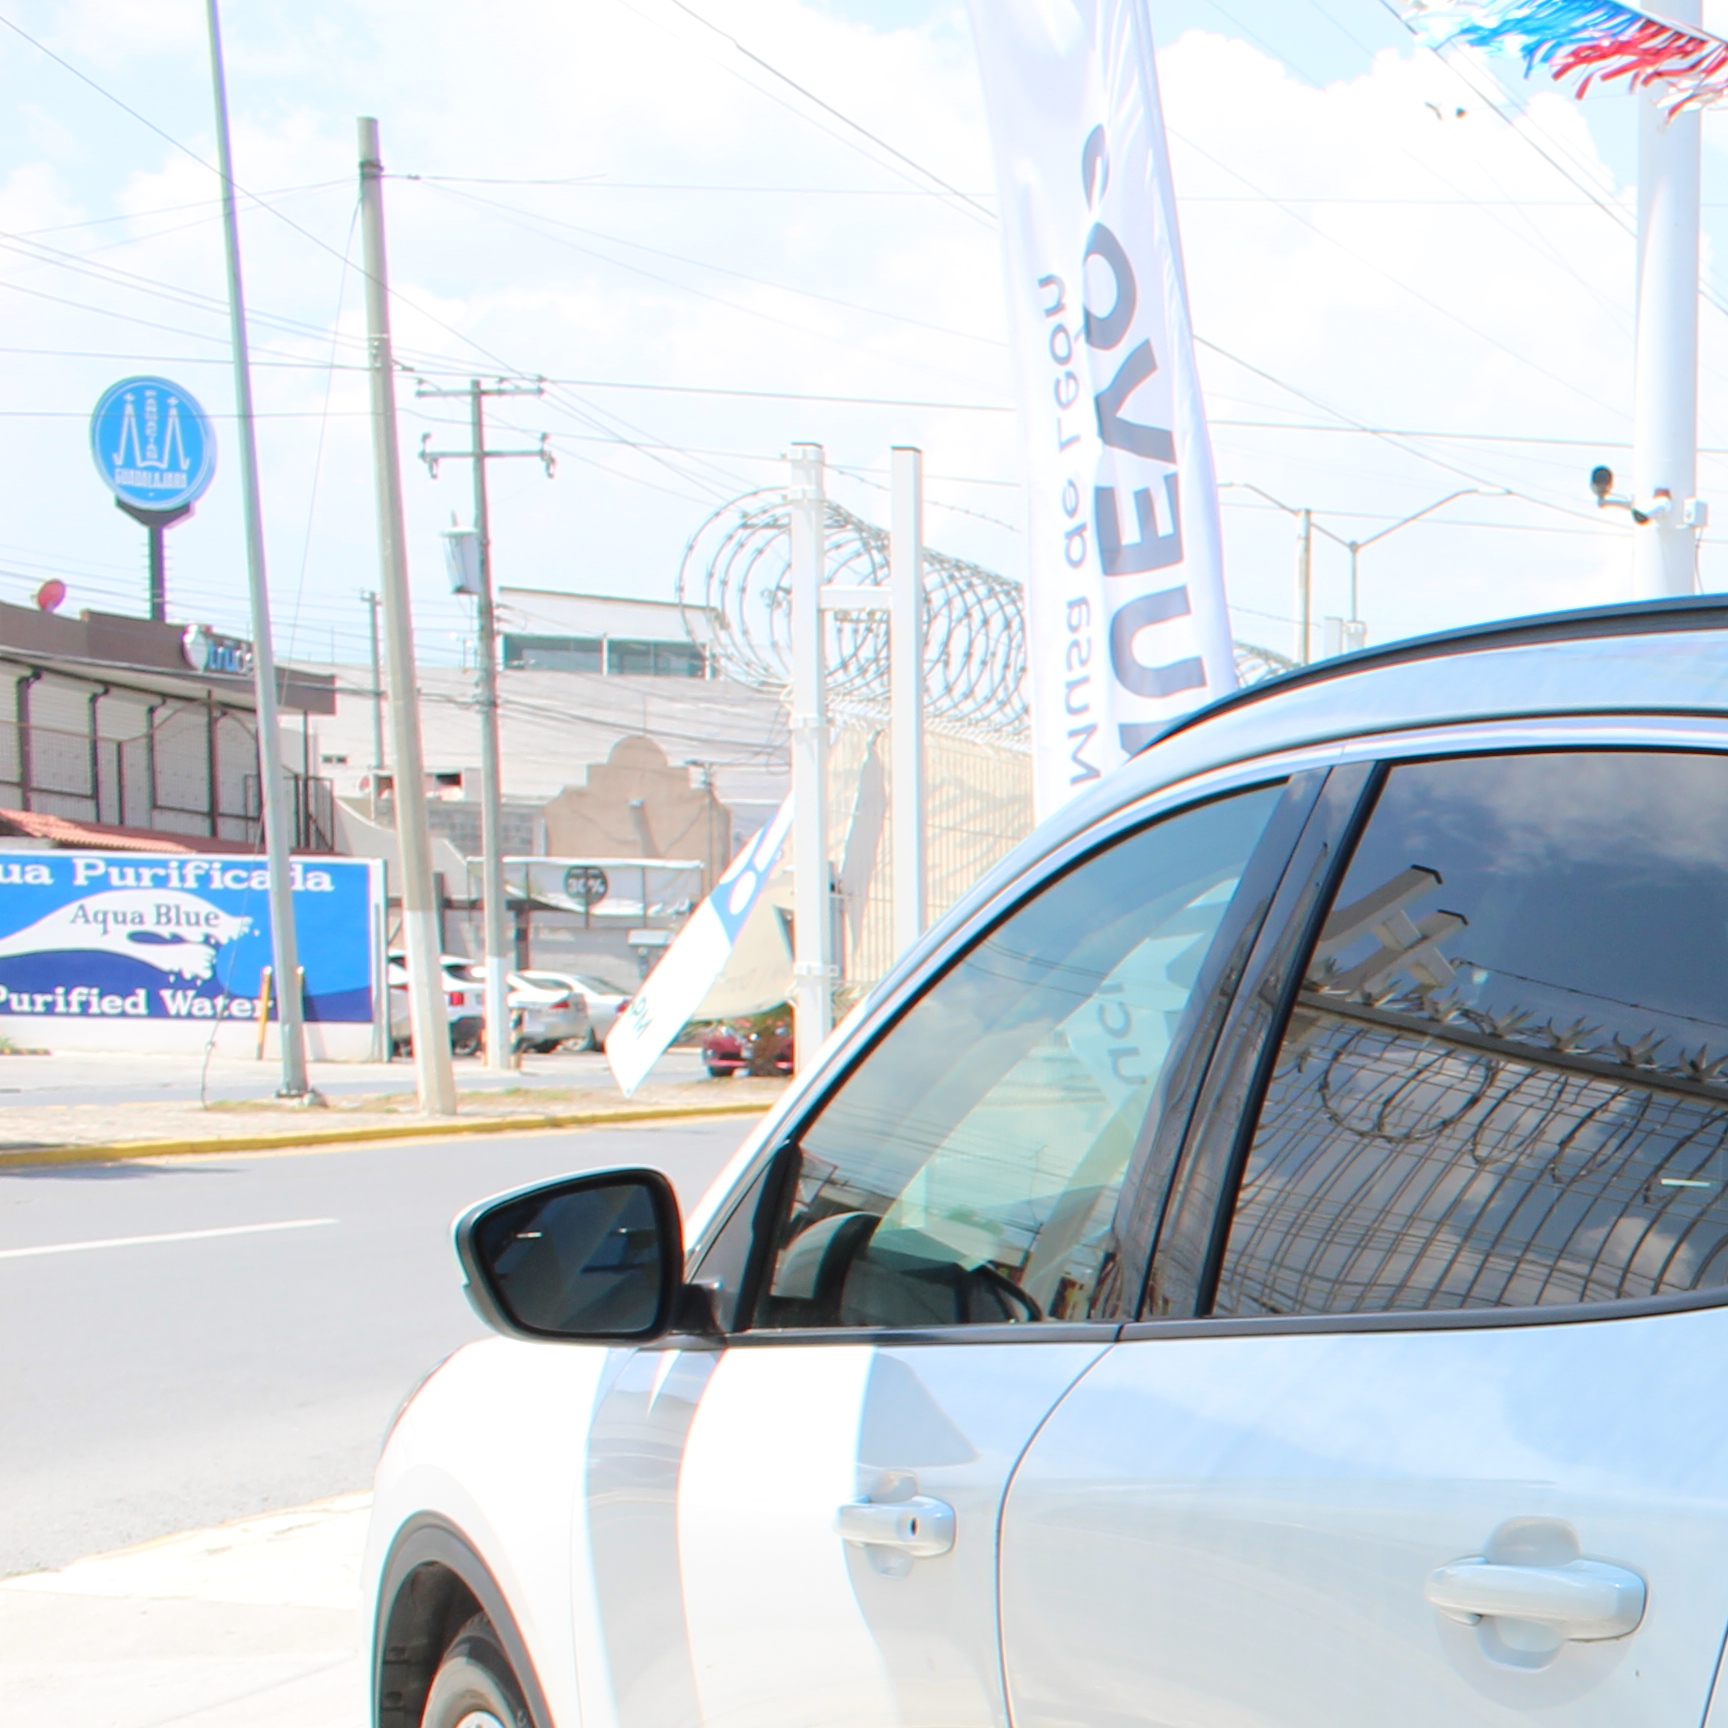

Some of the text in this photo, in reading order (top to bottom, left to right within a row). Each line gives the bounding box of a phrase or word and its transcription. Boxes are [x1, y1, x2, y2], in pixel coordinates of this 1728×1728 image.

[70, 903, 221, 937] Aqua Blue
[0, 984, 275, 1018] Purified Water
